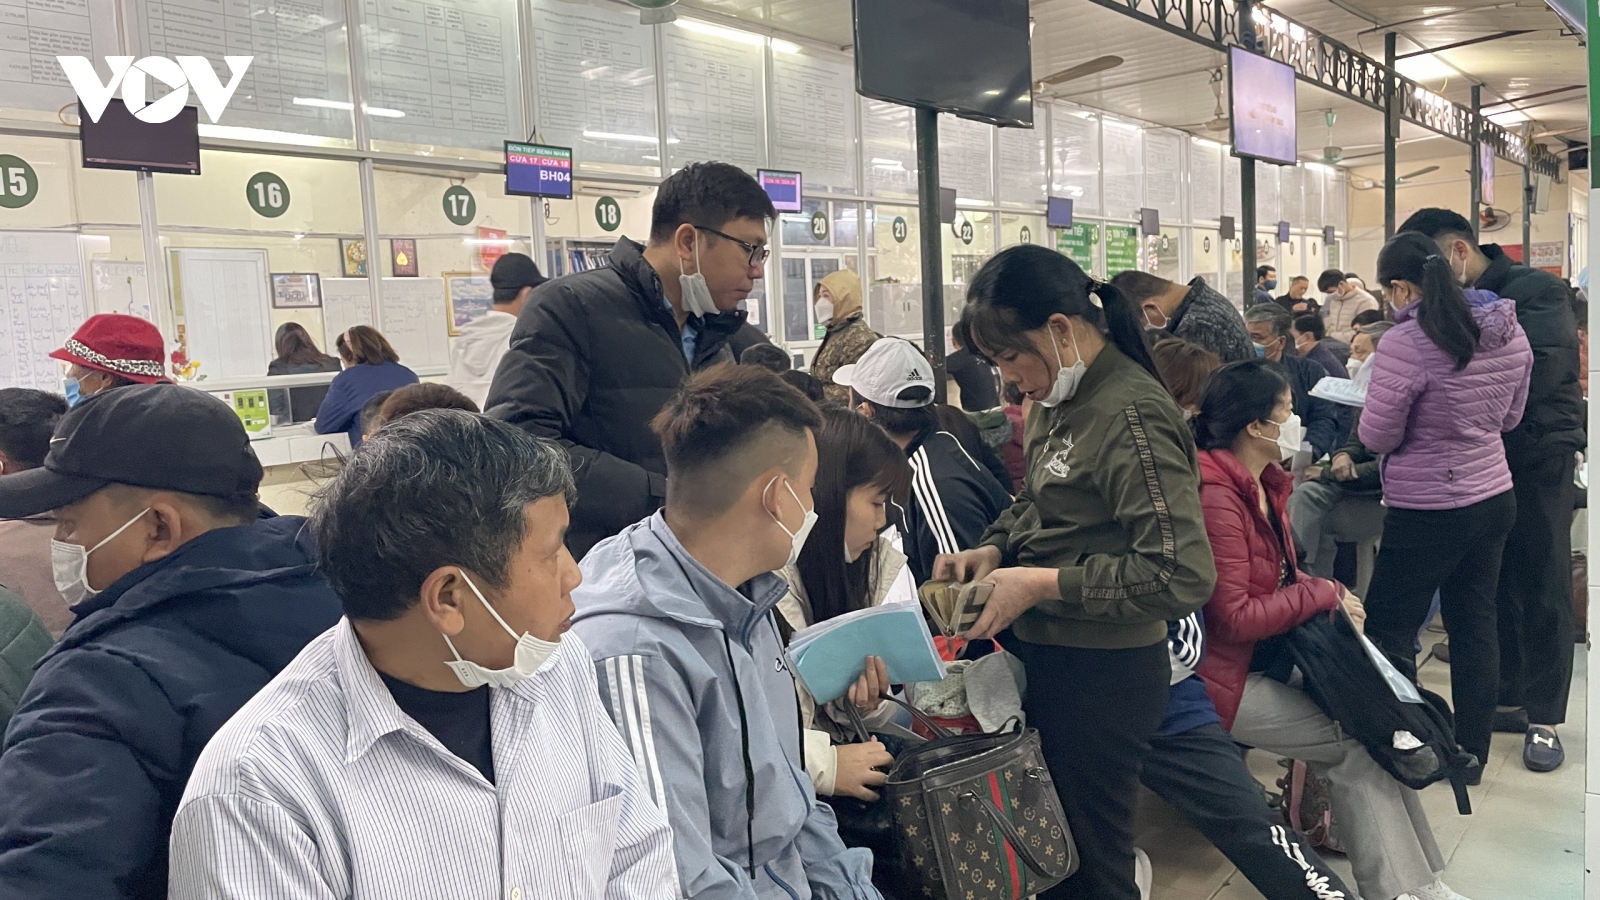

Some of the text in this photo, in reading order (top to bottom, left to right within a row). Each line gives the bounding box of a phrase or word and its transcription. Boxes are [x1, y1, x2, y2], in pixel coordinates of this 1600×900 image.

[540, 169, 570, 182] BH04
[253, 182, 283, 208] 16
[448, 194, 469, 217] 17
[599, 204, 617, 225] 18
[813, 217, 826, 235] 20
[895, 222, 905, 238] 21
[962, 225, 972, 240] 22
[1021, 230, 1030, 244] 23
